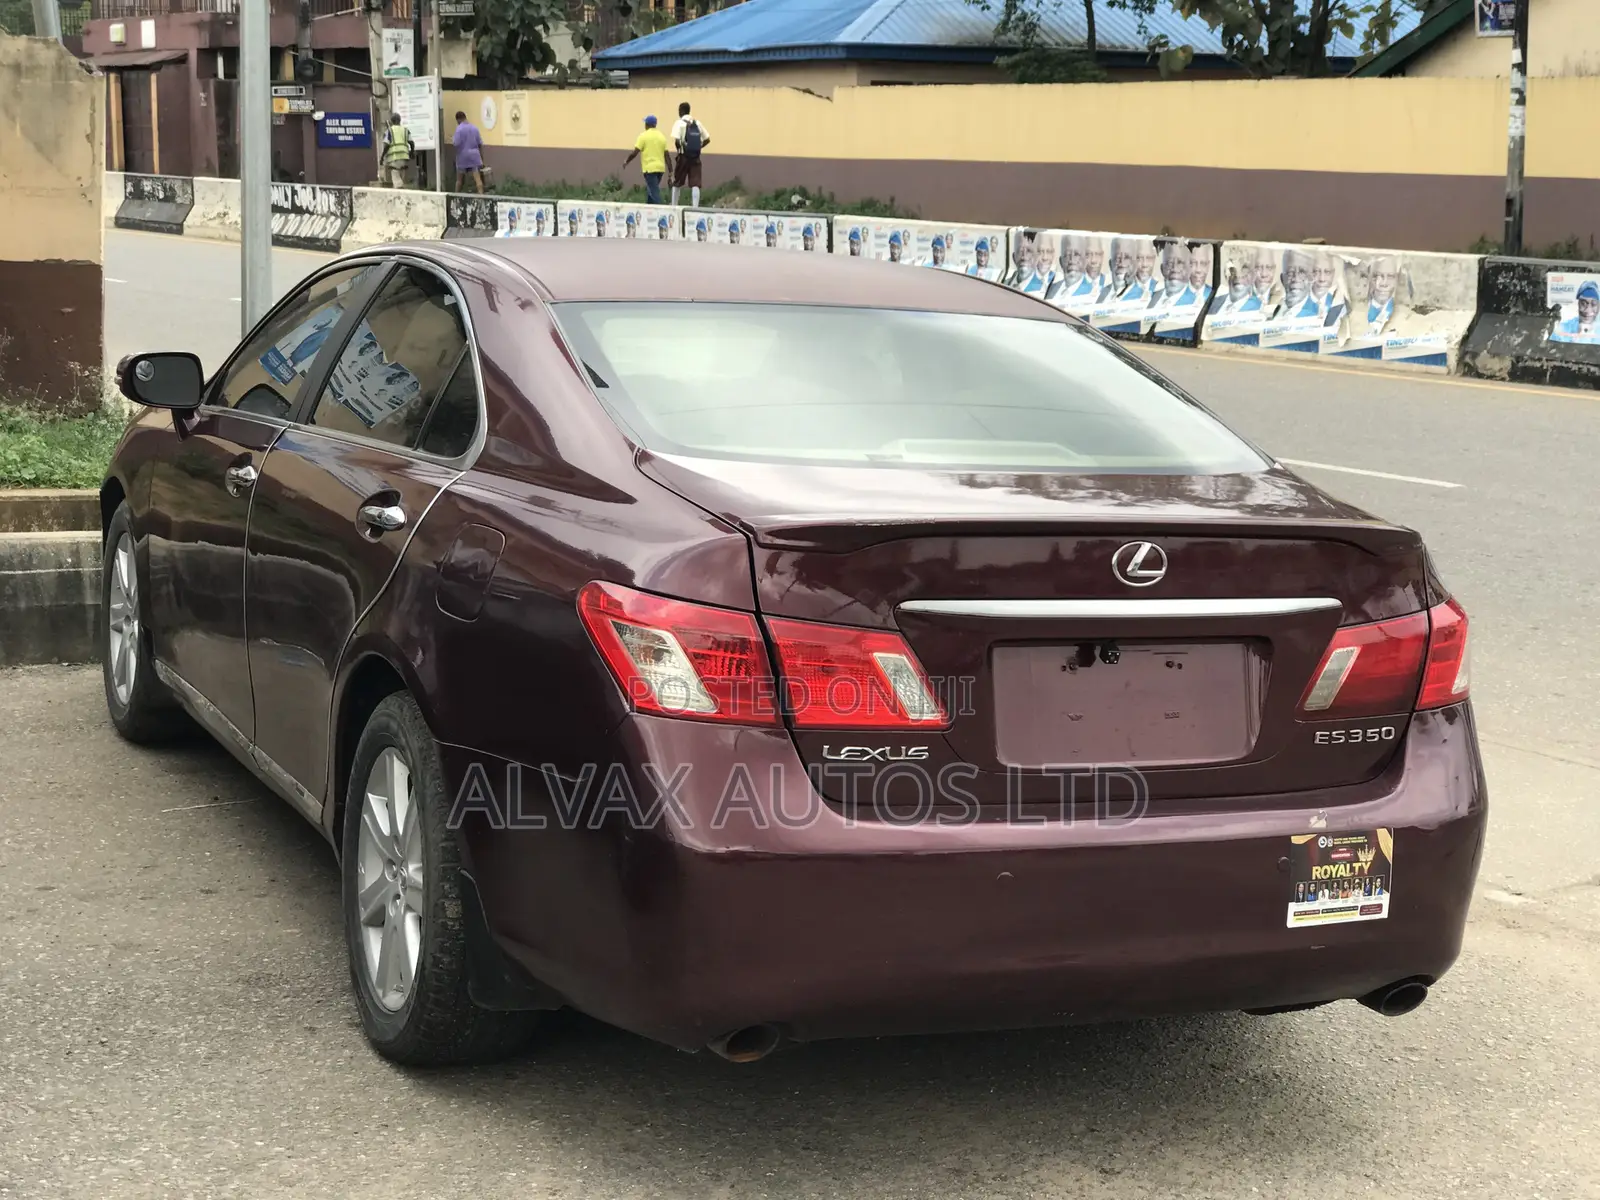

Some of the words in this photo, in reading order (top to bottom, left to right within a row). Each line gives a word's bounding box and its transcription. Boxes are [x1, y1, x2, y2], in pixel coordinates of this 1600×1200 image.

[1314, 726, 1395, 744] ES350
[823, 745, 929, 761] LEXUS
[1312, 861, 1372, 880] ROYALTY
